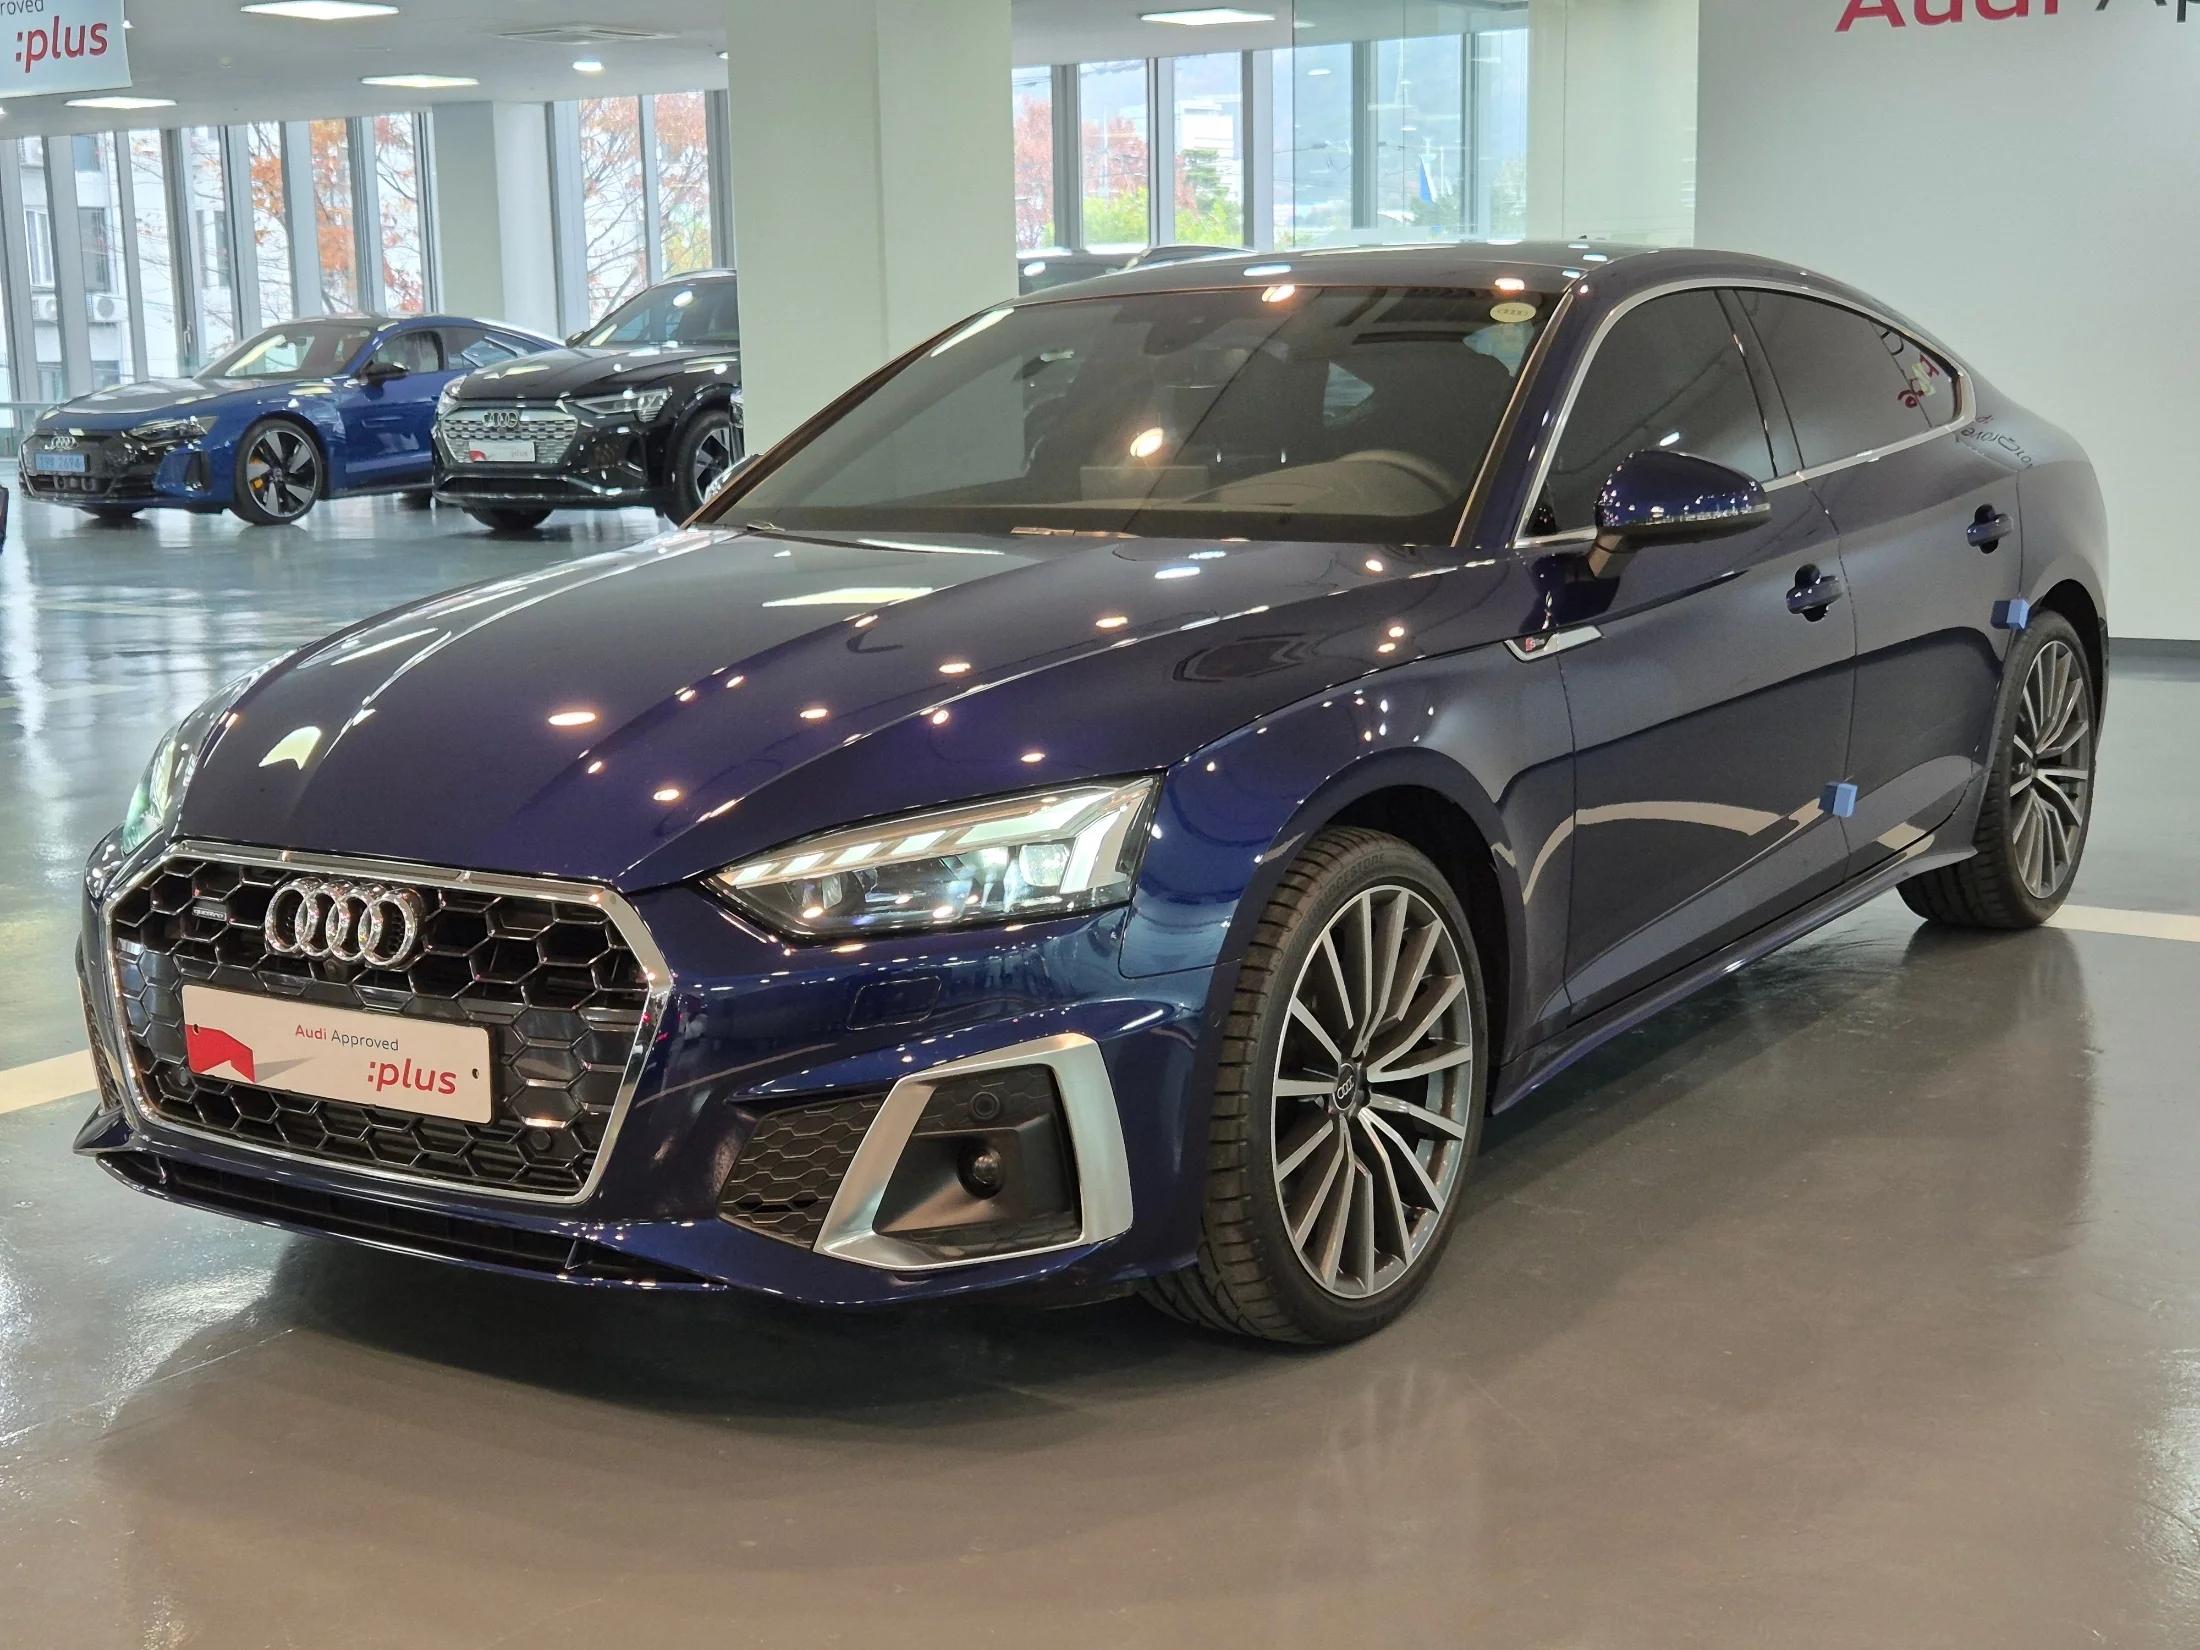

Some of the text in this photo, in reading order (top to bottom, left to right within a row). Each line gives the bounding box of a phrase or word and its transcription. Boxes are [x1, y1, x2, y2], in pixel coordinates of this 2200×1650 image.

[1834, 0, 2059, 32] Au
[16, 15, 108, 73] :plus
[295, 1024, 399, 1051] Audi Approved
[367, 1058, 457, 1095] :plus
